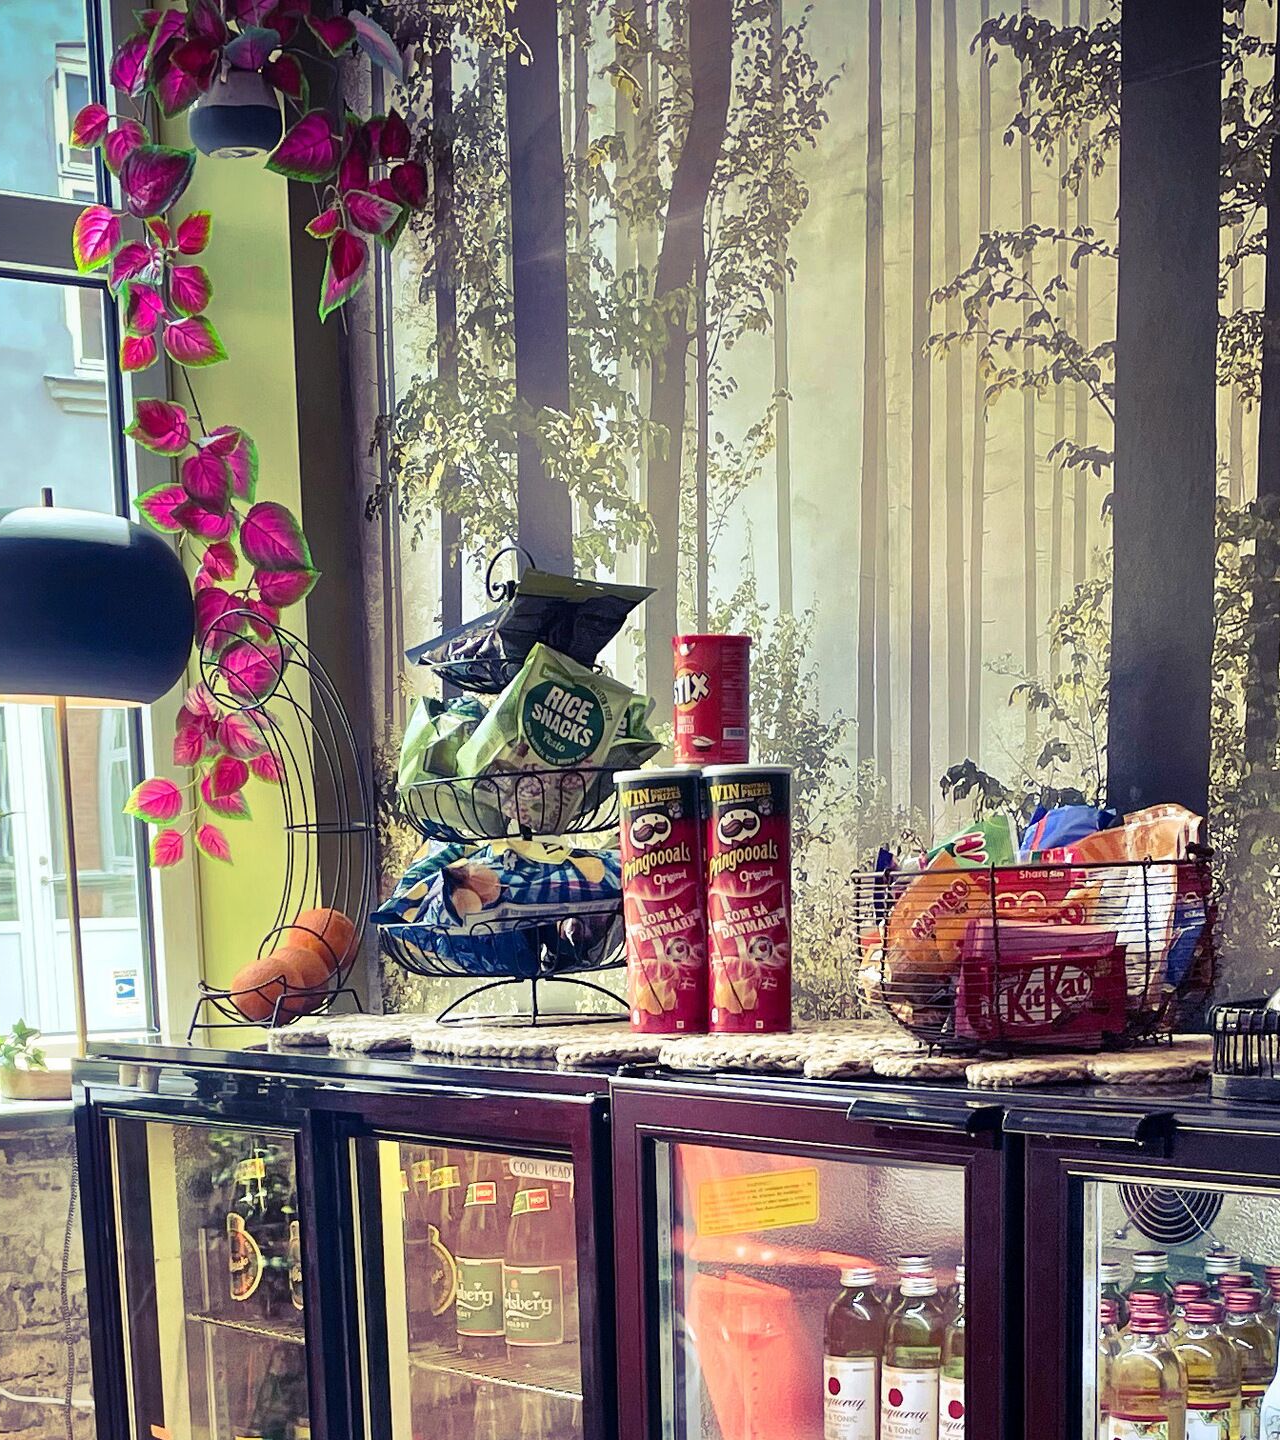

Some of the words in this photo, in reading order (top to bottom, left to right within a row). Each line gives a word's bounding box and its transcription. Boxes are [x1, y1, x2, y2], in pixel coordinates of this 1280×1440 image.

[544, 686, 594, 725] RICE
[531, 703, 593, 747] SNACKS
[621, 788, 649, 808] WIN
[651, 791, 681, 802] PRIZES
[710, 783, 740, 803] WIN
[623, 841, 691, 888] Pringoooals
[709, 838, 779, 885] Pringoooals
[1019, 869, 1047, 879] Share
[640, 911, 667, 927] KOM
[668, 903, 684, 918] SÅ
[724, 908, 751, 923] KOM
[753, 901, 769, 916] SÅ
[637, 915, 696, 942] DANMARK
[720, 913, 781, 939] DANMARK
[1007, 964, 1089, 1026] KitKat
[513, 1161, 541, 1176] COOL
[545, 1164, 572, 1179] HEAD
[456, 1283, 493, 1307] sberg
[504, 1292, 553, 1315] rlsberg
[825, 1399, 866, 1411] queray
[883, 1408, 929, 1423] queray
[834, 1415, 858, 1423] TONIC
[894, 1427, 921, 1435] TONIC
